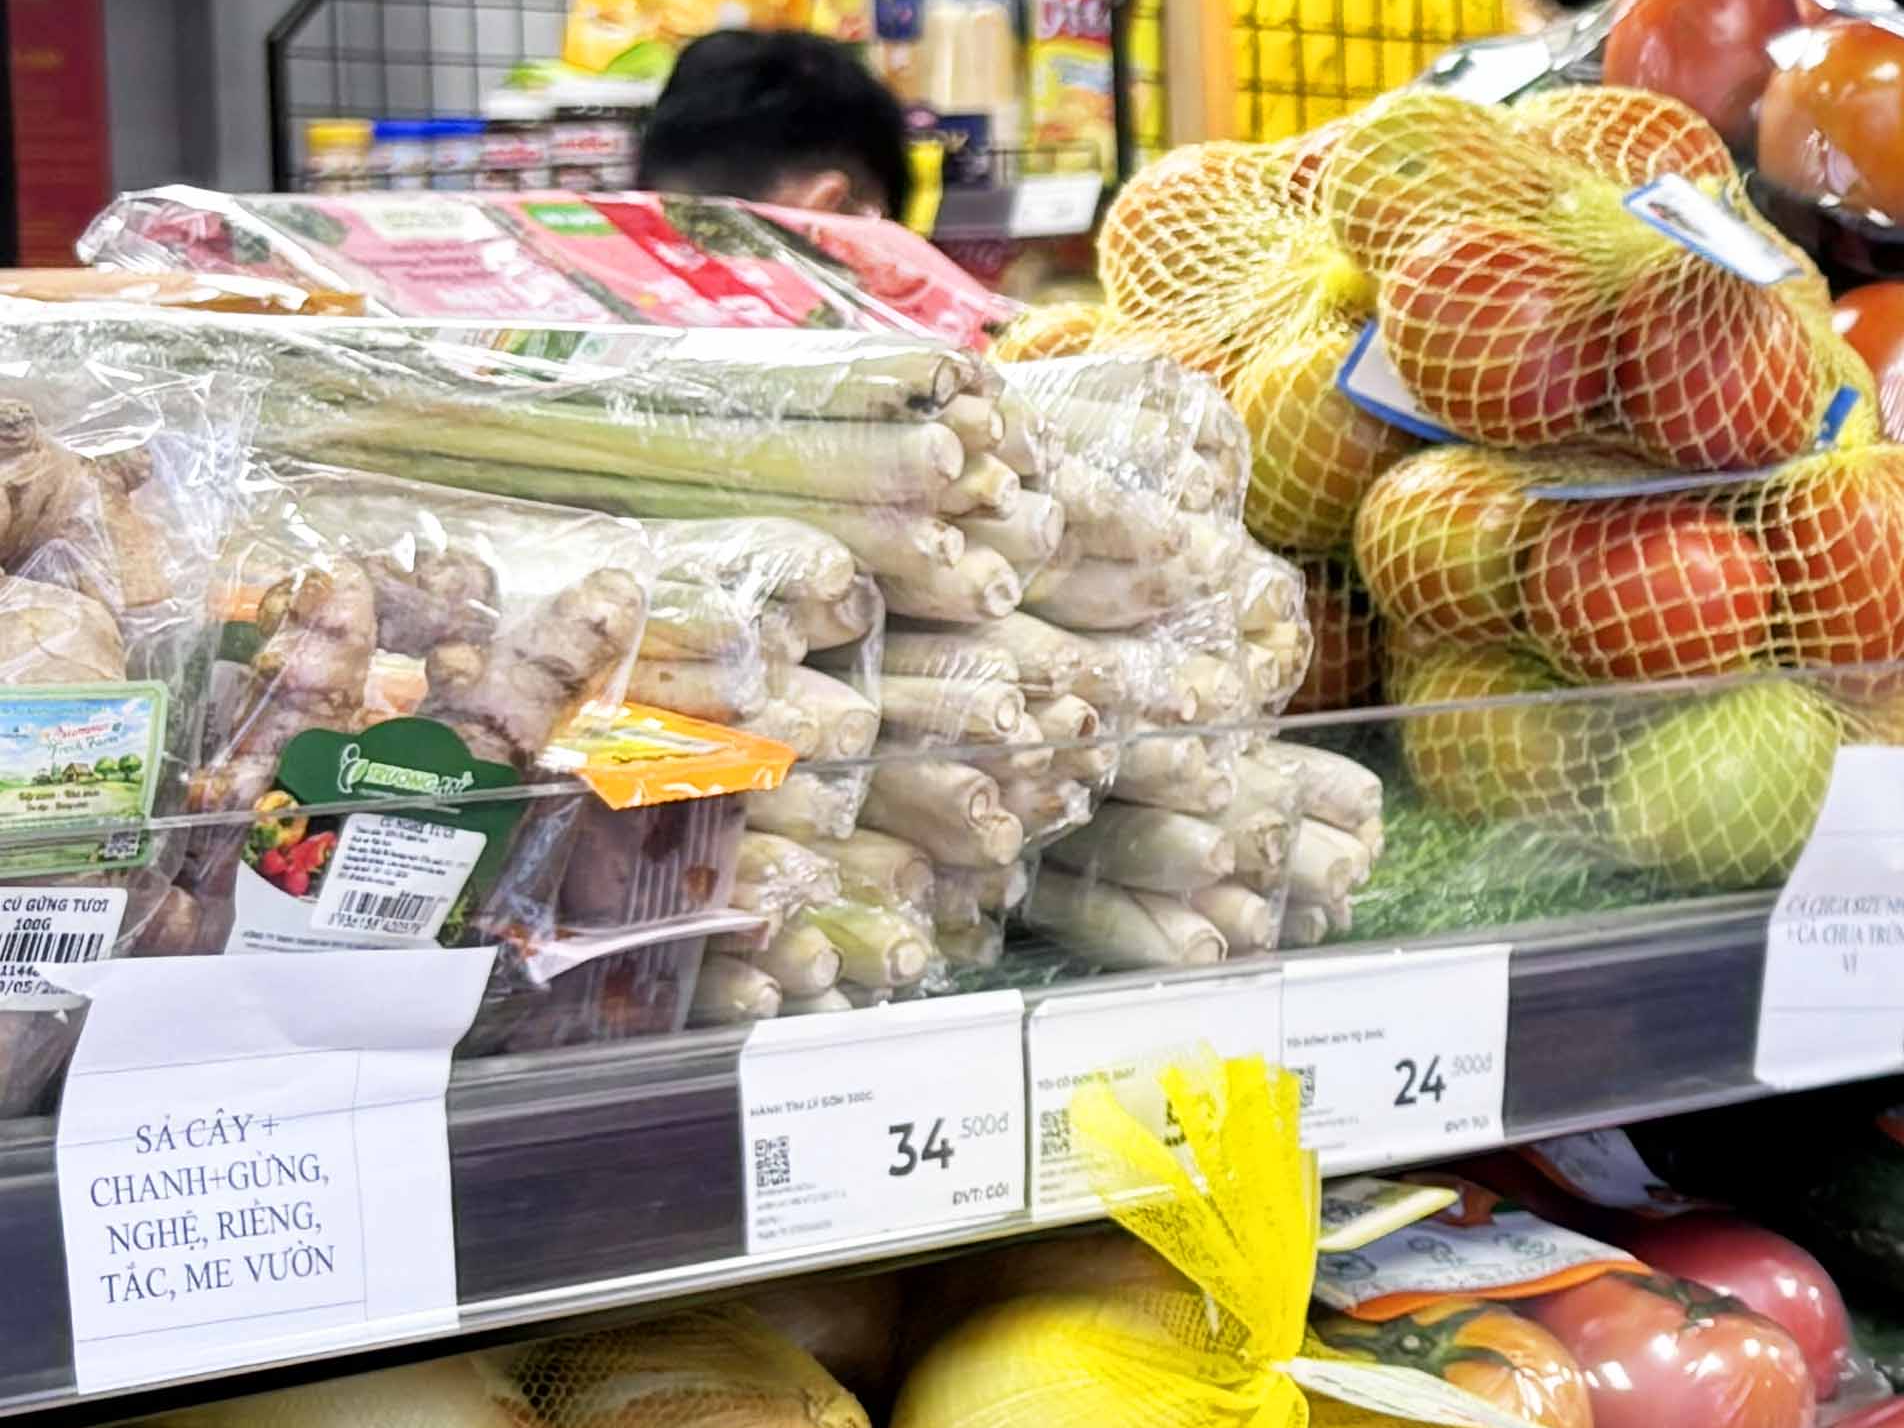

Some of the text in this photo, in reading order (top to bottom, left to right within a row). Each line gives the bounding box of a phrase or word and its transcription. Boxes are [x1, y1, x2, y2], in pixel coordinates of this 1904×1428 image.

[13, 917, 53, 932] 100G
[26, 894, 69, 912] GỪNG
[1393, 1054, 1447, 1108] 24
[183, 1108, 255, 1146] CÂY
[887, 1115, 956, 1177] 34
[107, 1197, 324, 1256] NGHỆ, RIỀNG,
[100, 1239, 337, 1305] TẮC, ME VƯỜN
